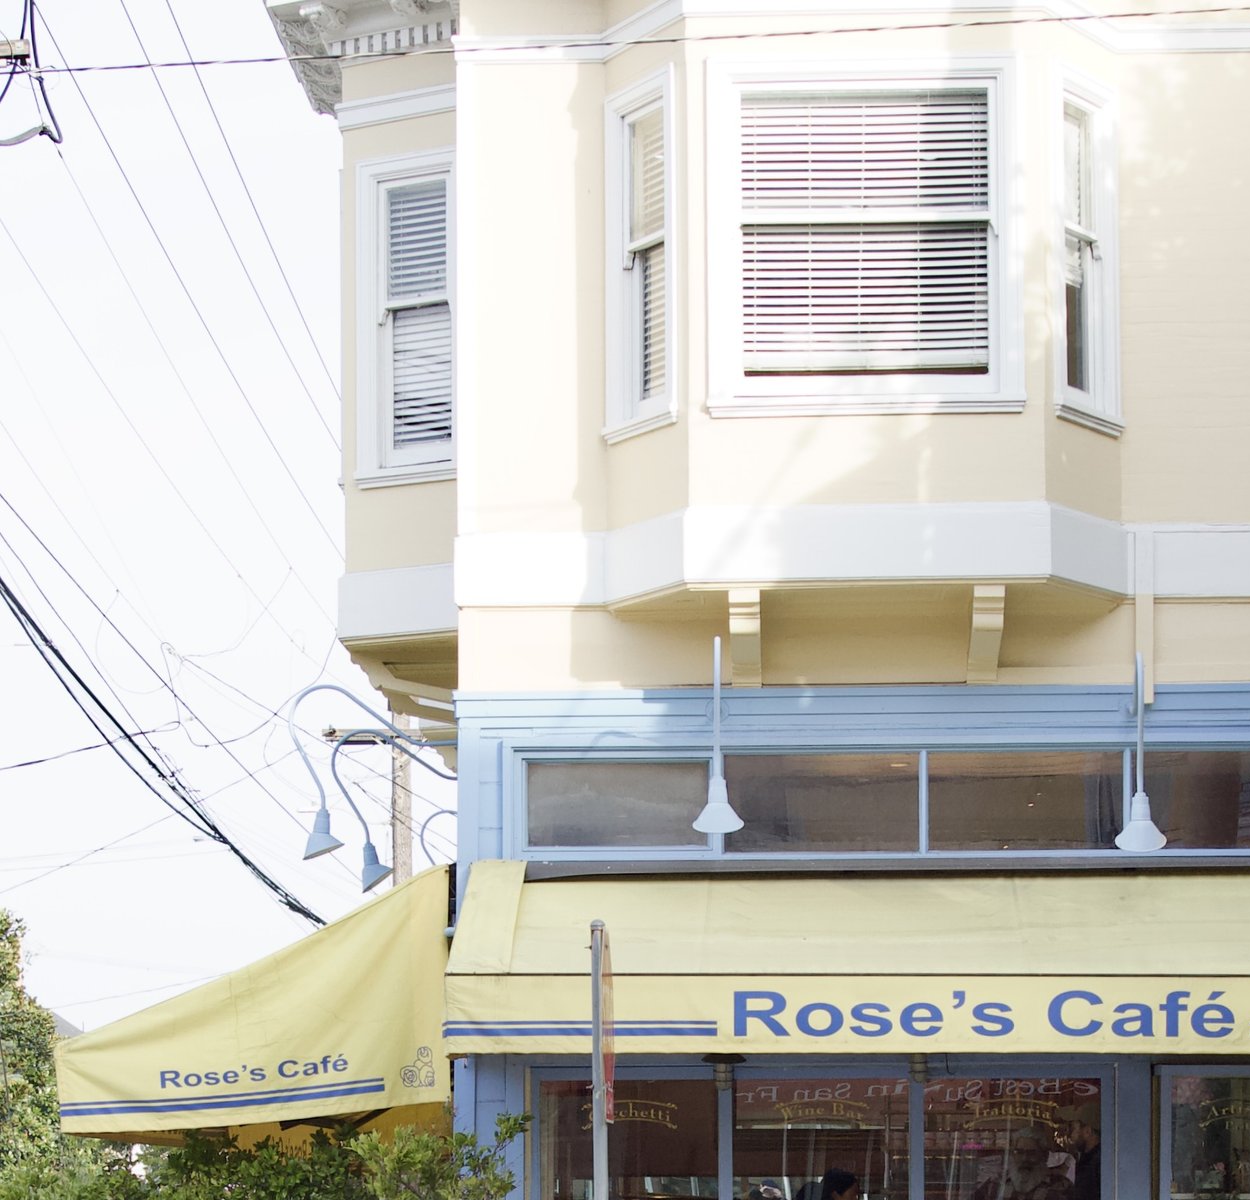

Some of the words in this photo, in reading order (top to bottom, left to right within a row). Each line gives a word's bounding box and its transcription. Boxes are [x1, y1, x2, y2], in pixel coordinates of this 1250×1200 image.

[1047, 990, 1234, 1037] Café
[277, 1053, 349, 1079] Café
[779, 1103, 825, 1119] Wine
[832, 1102, 865, 1120] Bar
[973, 1103, 1050, 1119] Trattoria
